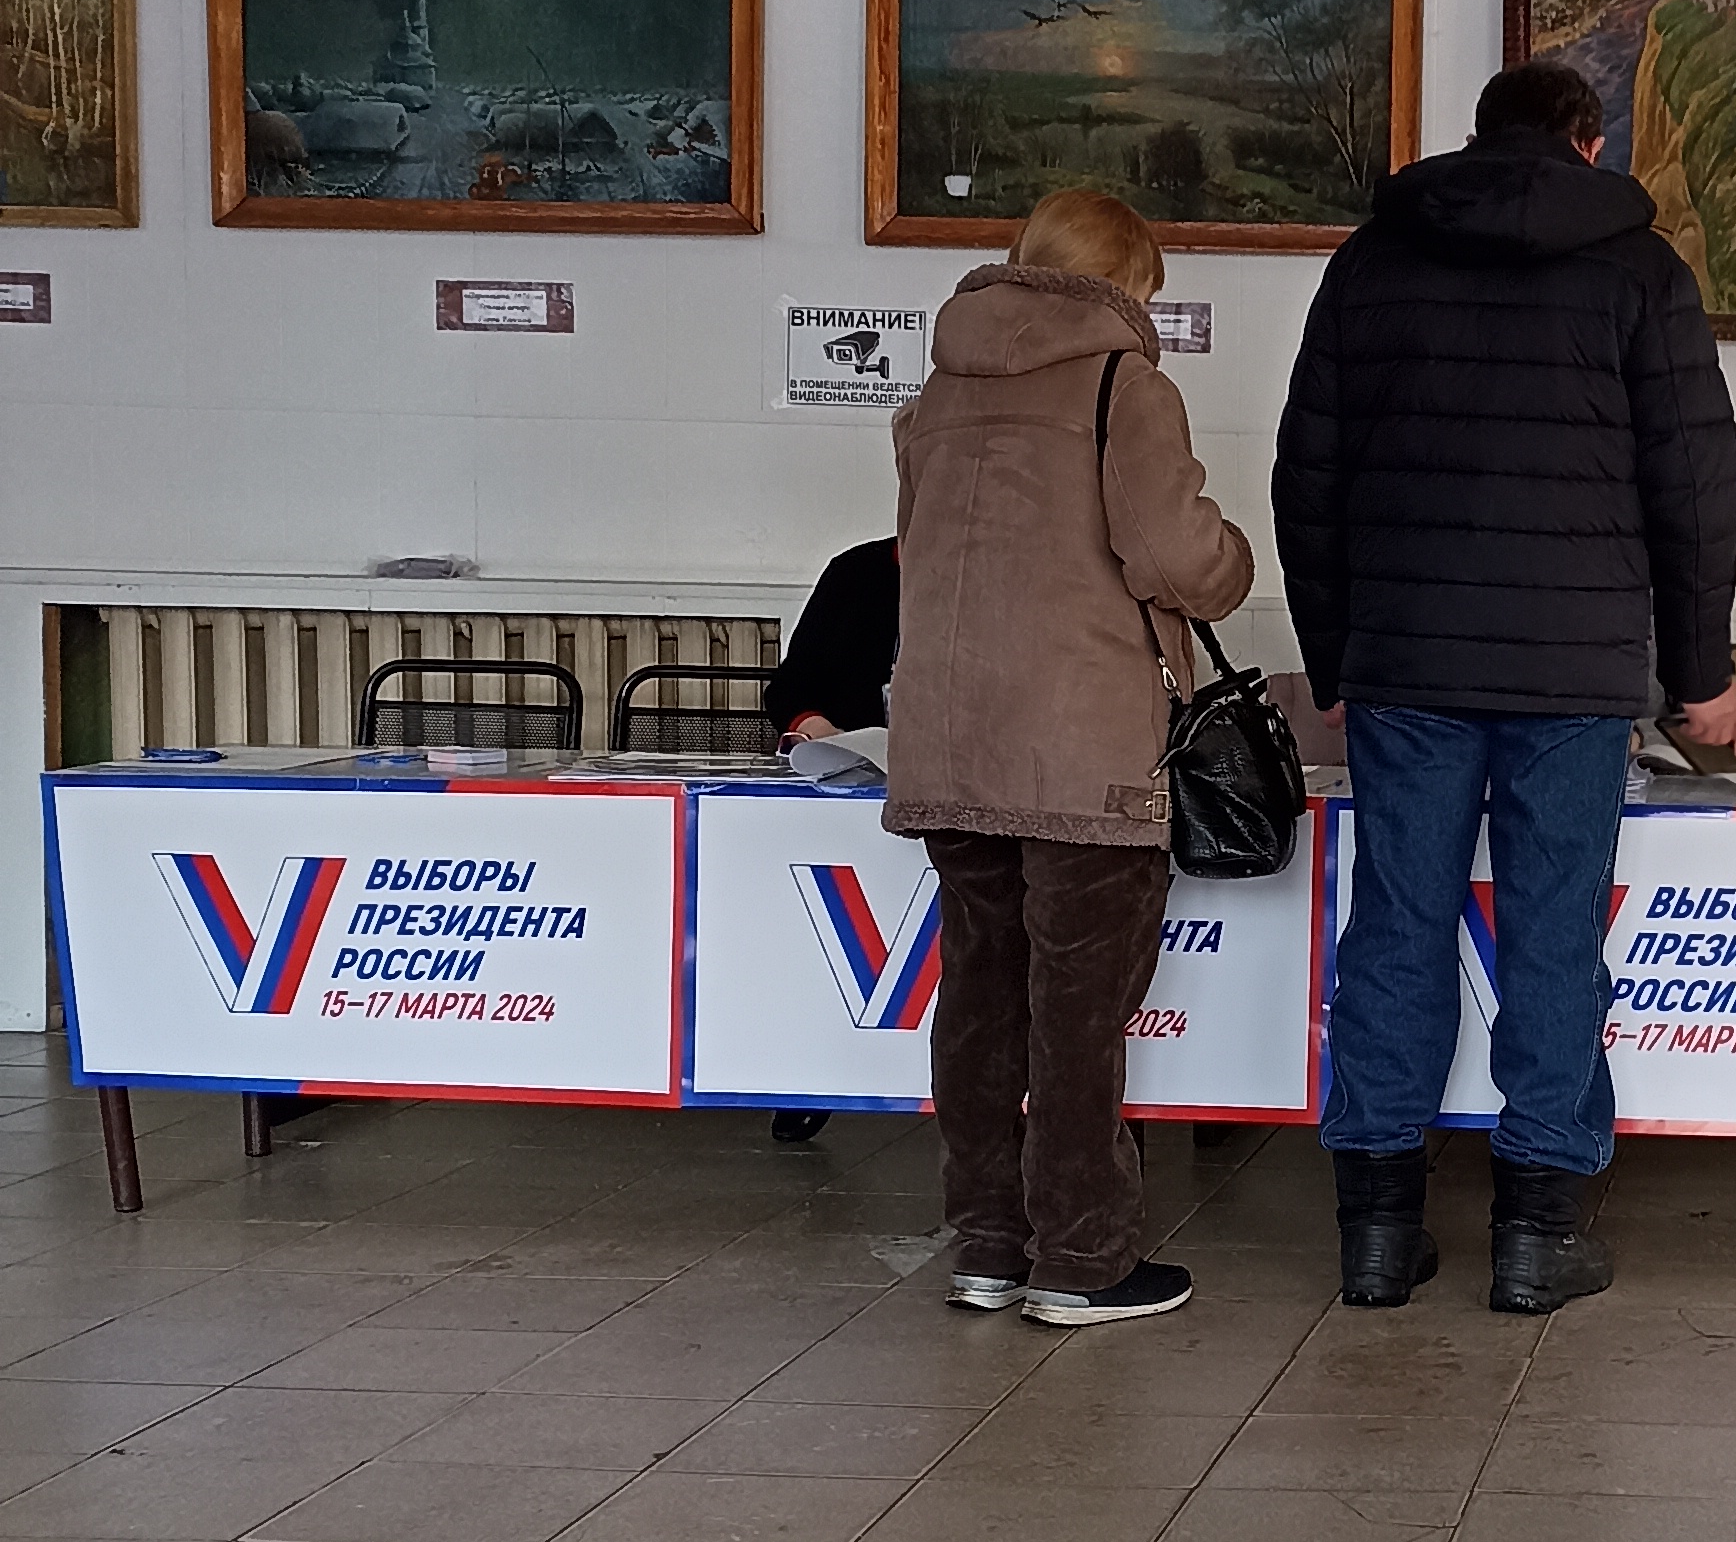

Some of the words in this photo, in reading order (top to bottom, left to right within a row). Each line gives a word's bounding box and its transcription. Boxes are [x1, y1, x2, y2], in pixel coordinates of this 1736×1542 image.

[790, 309, 923, 330] ВНИМАНИЕ!
[790, 379, 797, 388] В
[800, 380, 869, 390] ПОМЕЩЕНИИ
[872, 382, 921, 392] ВЕДЕТСЯ
[365, 858, 536, 893] ВЫБОРЫ
[348, 904, 587, 941] ПРЕЗИДЕНТА
[331, 948, 486, 982] РОССИИ
[394, 992, 486, 1021] МАРТА
[490, 994, 556, 1022] 2024
[1123, 1009, 1187, 1038] 2024
[1604, 1023, 1669, 1051] 5–17
